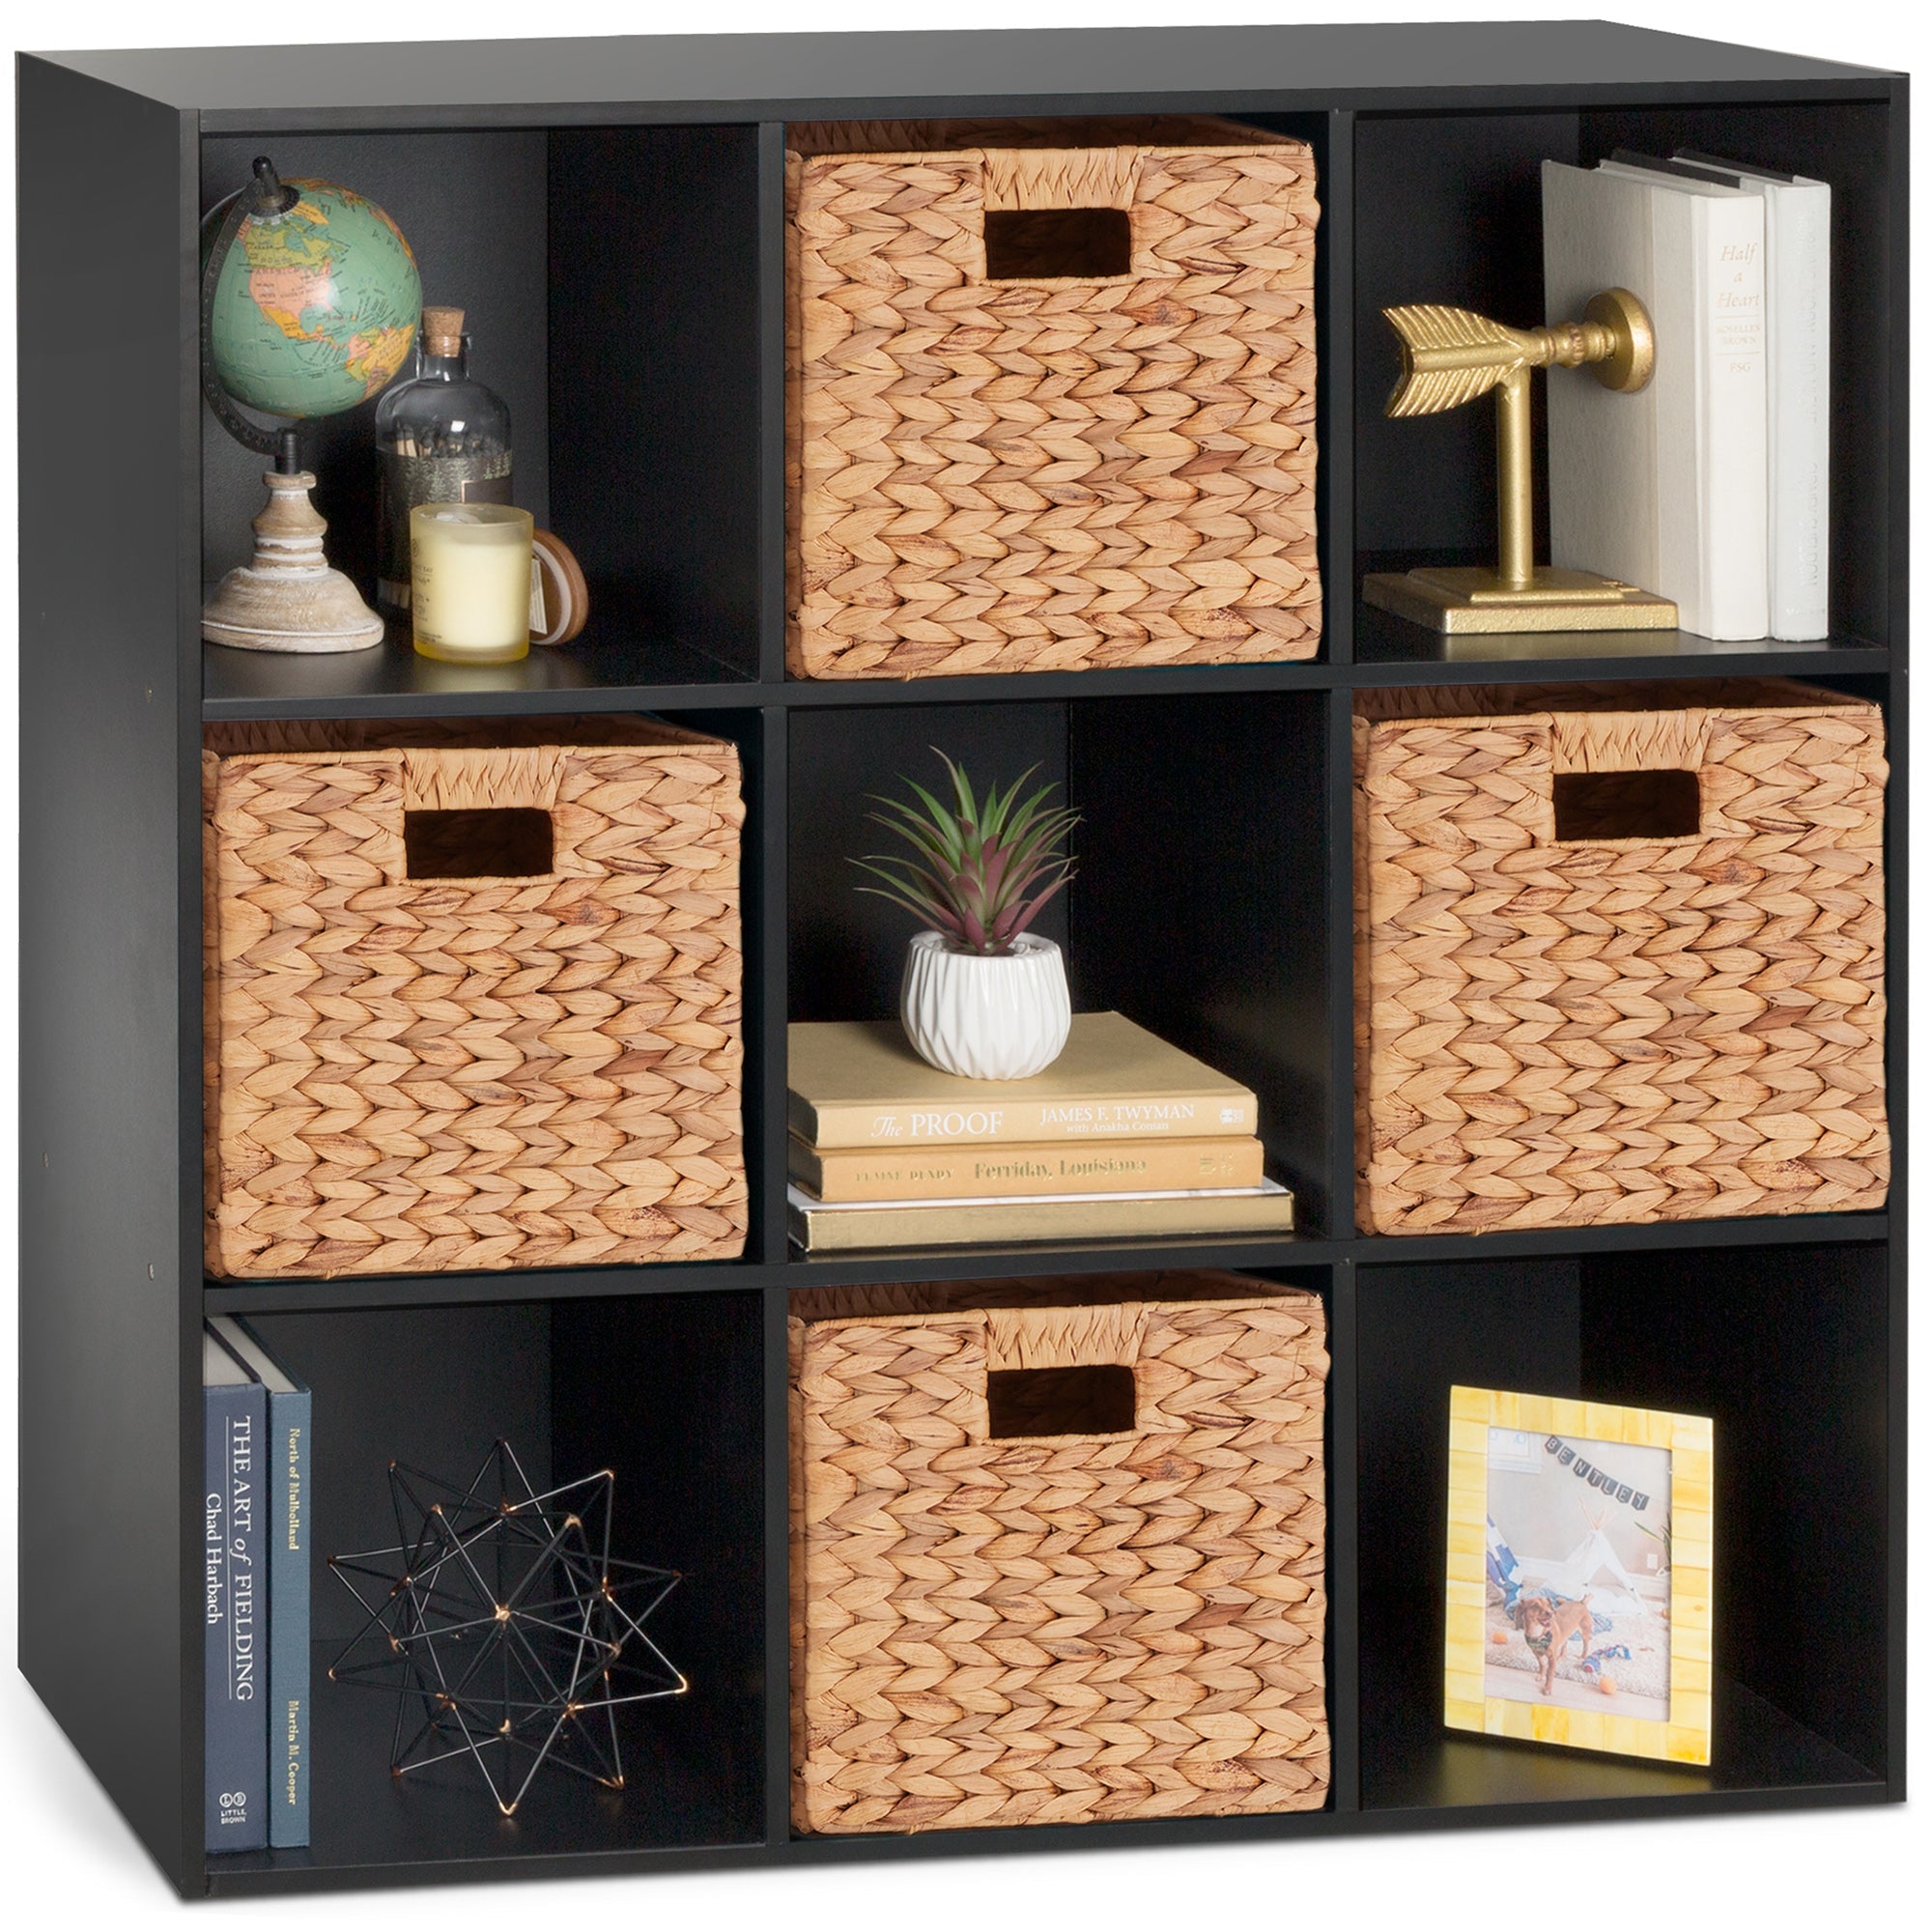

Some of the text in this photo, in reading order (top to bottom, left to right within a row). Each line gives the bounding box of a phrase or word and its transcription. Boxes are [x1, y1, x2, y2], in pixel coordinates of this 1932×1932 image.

[1719, 242, 1758, 266] Half
[1733, 271, 1743, 283] a
[1717, 292, 1761, 308] Heart
[871, 1112, 1004, 1137] The PROOF
[1040, 1103, 1194, 1125] JAMES F. TWYMAN
[1066, 1122, 1089, 1133] with
[976, 1158, 1148, 1180] Ferriday, Louisiana
[1546, 1436, 1649, 1510] BENTLEY
[289, 1429, 300, 1549] North of Mulholland
[206, 1493, 223, 1624] Chad Harbach
[230, 1415, 254, 1701] THE ART of FIELDING
[289, 1700, 299, 1742] Martin
[286, 1762, 299, 1805] Cooper
